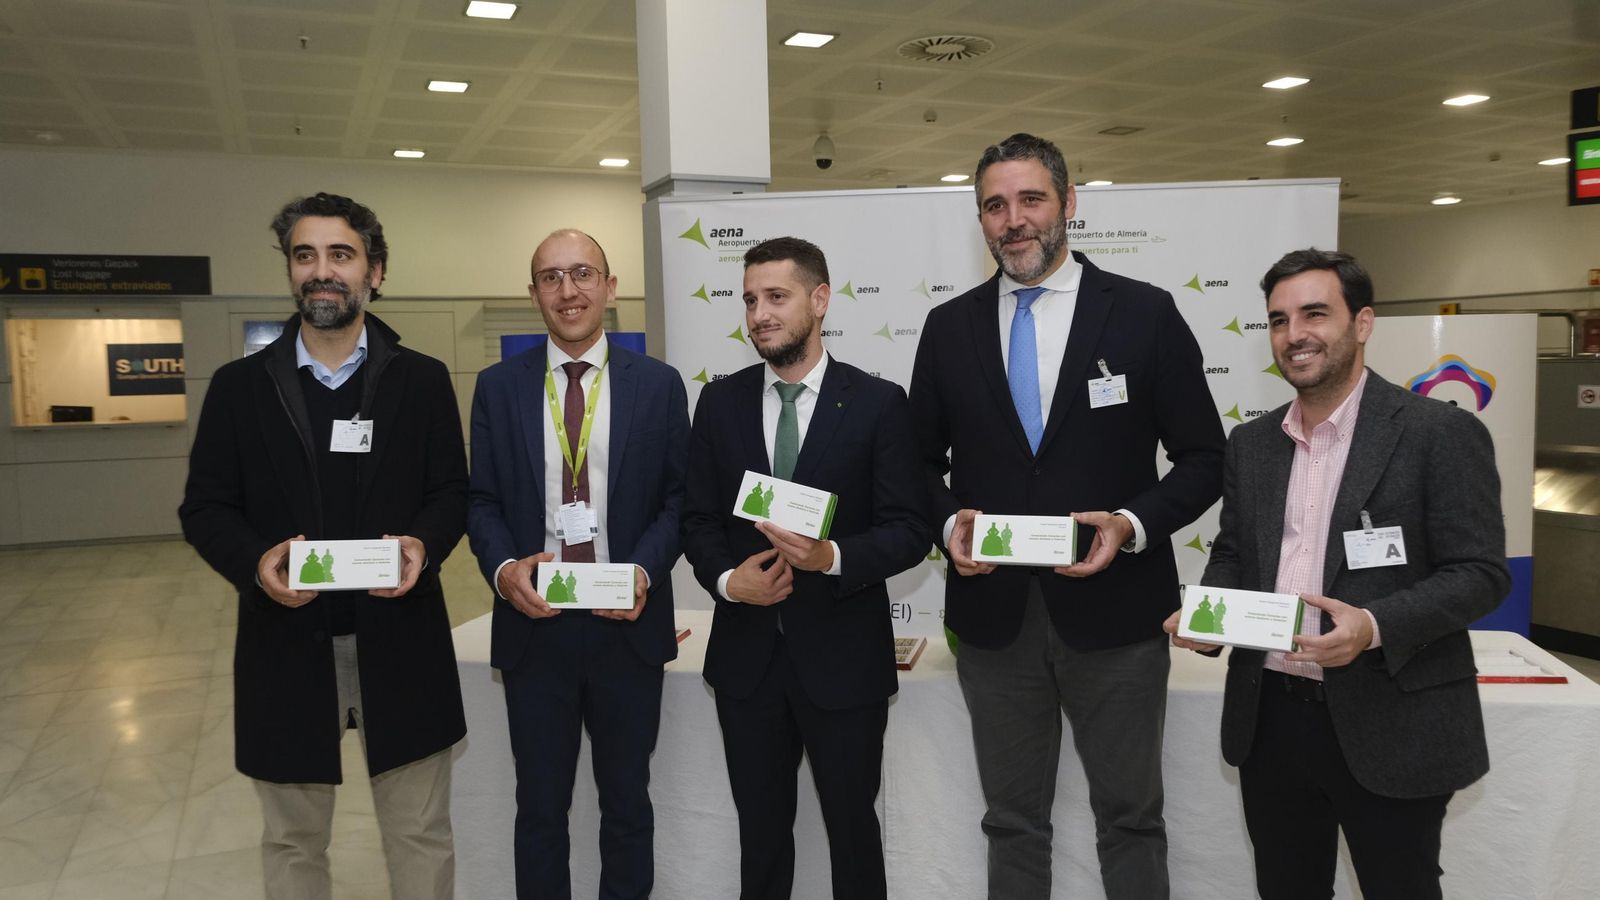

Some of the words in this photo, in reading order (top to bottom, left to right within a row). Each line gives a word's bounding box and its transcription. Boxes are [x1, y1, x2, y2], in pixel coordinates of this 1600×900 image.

[1067, 219, 1086, 230] na
[710, 228, 743, 238] aena
[1065, 231, 1104, 240] eropuerto
[1105, 230, 1115, 238] de
[1117, 229, 1147, 238] Almería
[718, 239, 760, 248] Aeropuerto
[1111, 247, 1130, 255] para
[53, 280, 107, 292] Equipajes
[111, 281, 172, 290] extraviados
[1204, 279, 1229, 288] aena
[710, 288, 733, 297] aena
[856, 285, 879, 294] aena
[931, 284, 954, 293] aena
[1244, 322, 1268, 331] aena
[820, 329, 844, 337] aena
[895, 327, 917, 336] aena
[1205, 366, 1229, 375] aena
[359, 433, 369, 446] A
[1385, 543, 1401, 559] A
